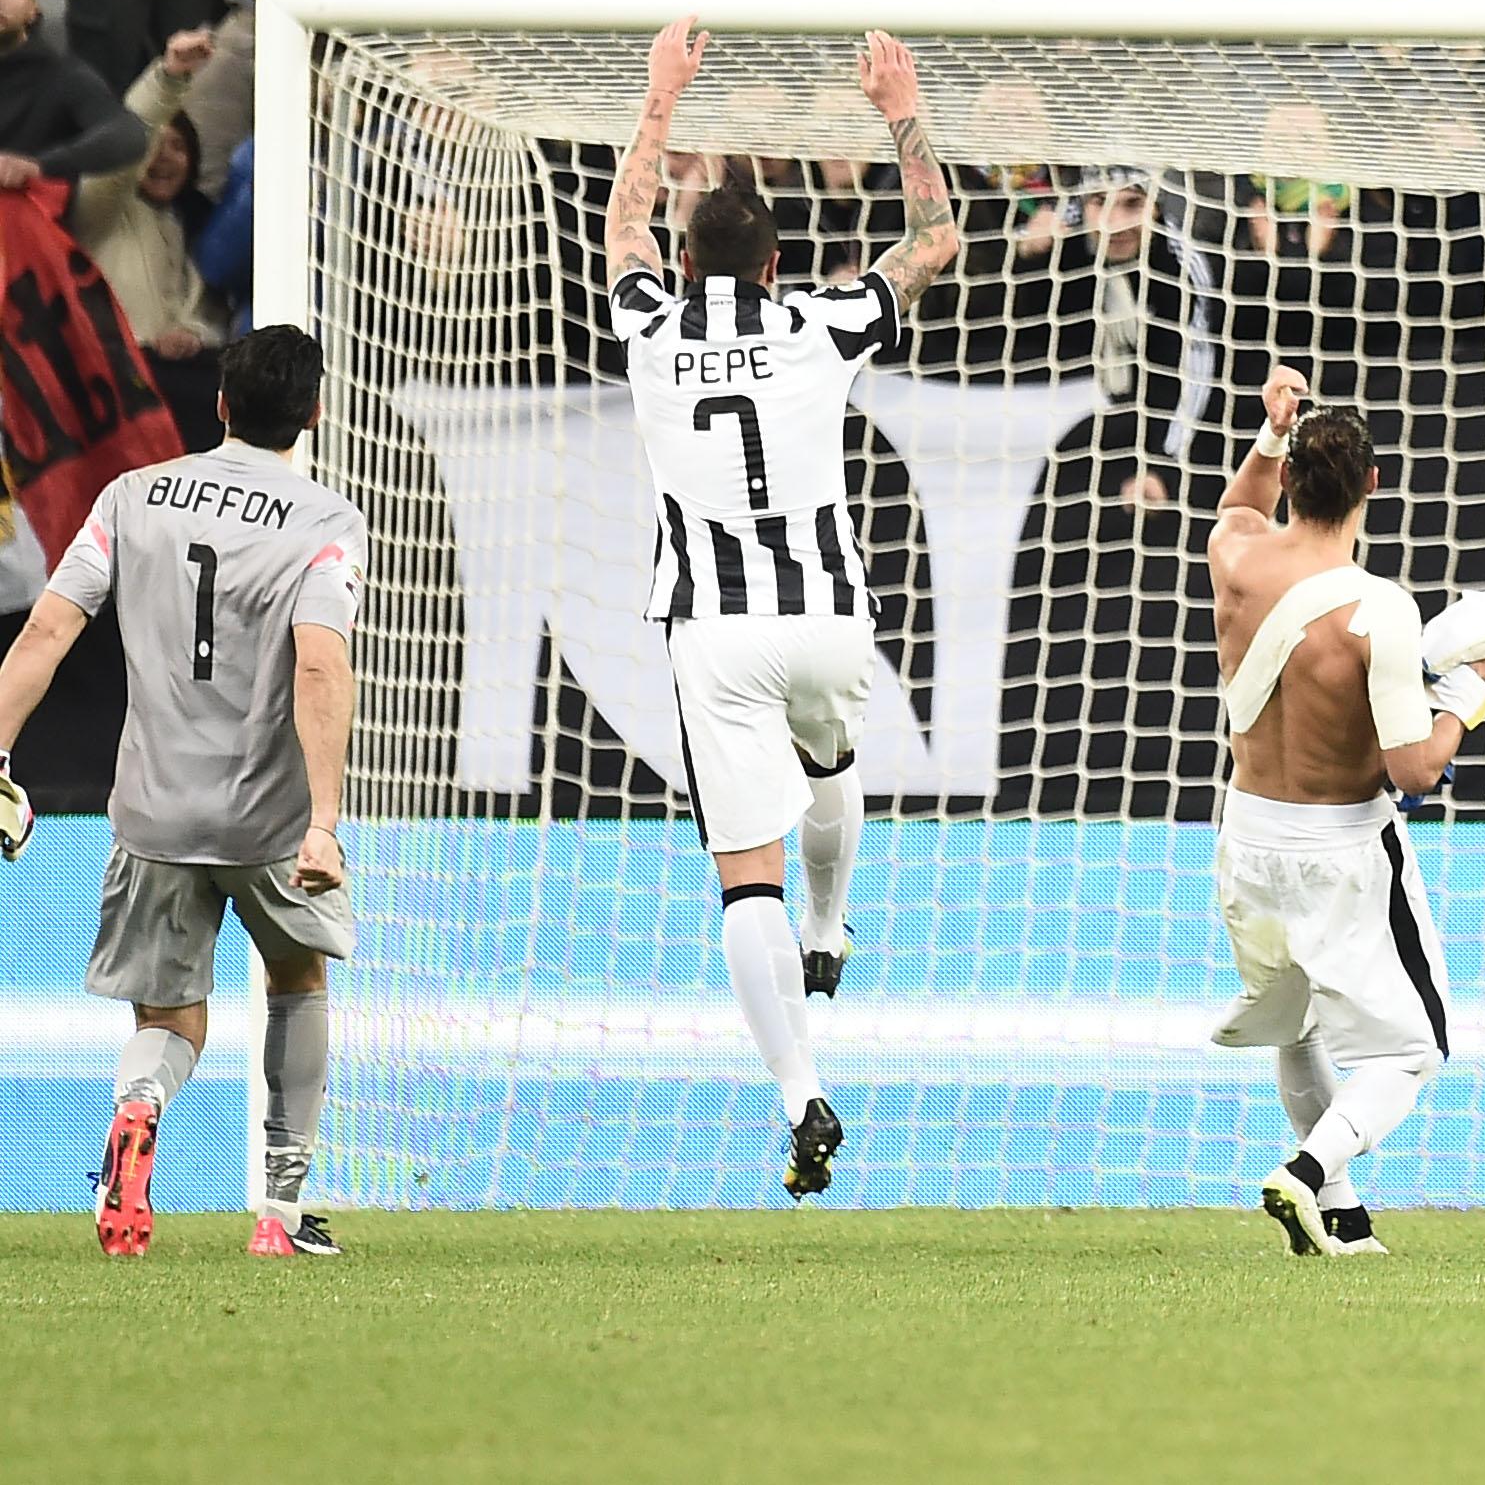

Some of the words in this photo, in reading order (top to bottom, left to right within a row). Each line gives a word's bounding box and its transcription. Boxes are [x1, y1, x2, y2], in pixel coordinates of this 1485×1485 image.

[675, 346, 775, 385] PEPE
[693, 395, 769, 510] 7
[146, 476, 294, 531] BUFFON
[186, 543, 217, 680] 1
